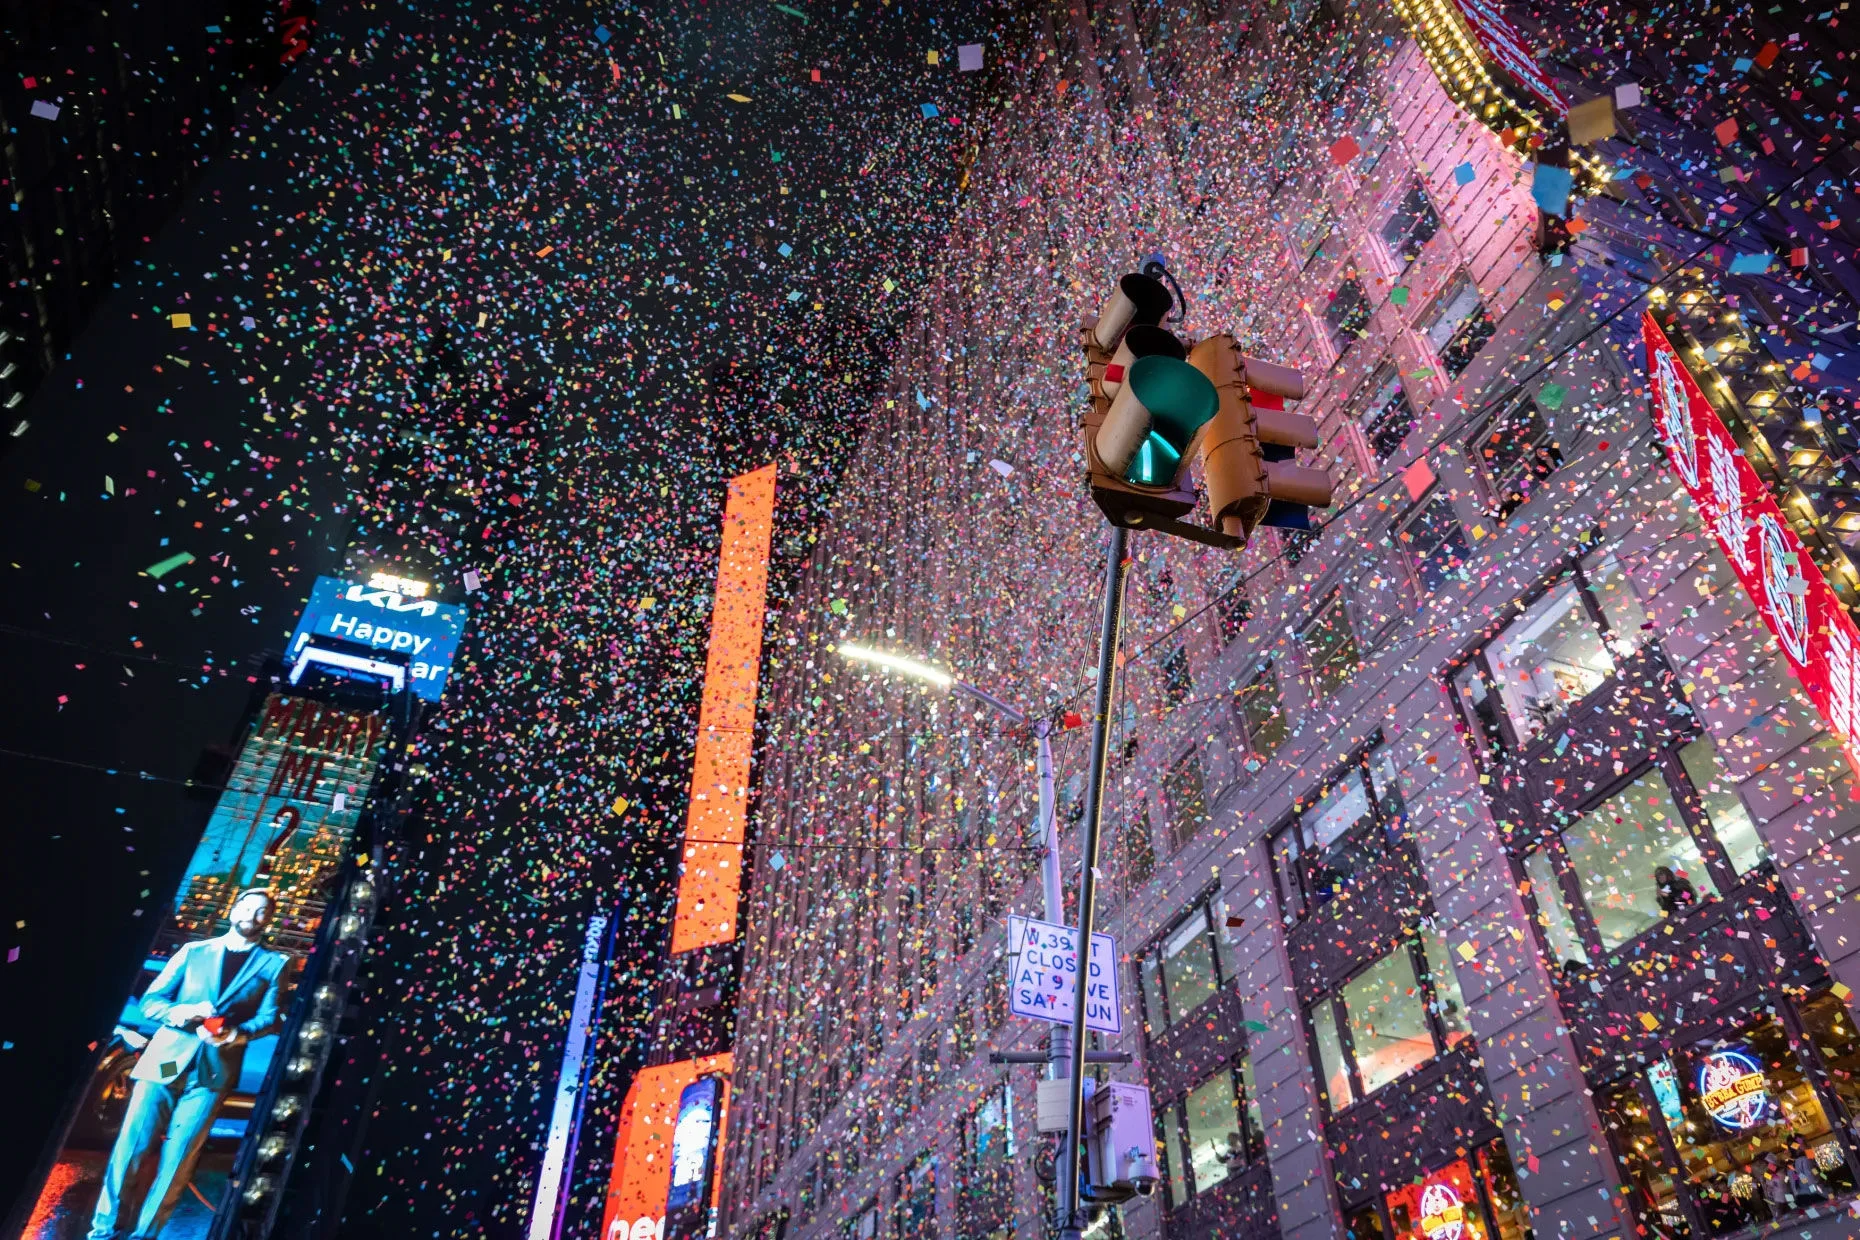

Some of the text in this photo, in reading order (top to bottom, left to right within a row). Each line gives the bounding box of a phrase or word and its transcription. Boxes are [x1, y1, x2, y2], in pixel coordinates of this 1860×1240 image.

[330, 613, 432, 655] Happy
[412, 661, 445, 681] ar
[258, 696, 386, 761] MARRY
[274, 751, 334, 803] ME
[1048, 934, 1072, 951] 39
[1027, 950, 1101, 977] CLOSD
[1021, 969, 1045, 986] AT
[1072, 982, 1109, 1000] VE
[1086, 1003, 1111, 1022] UN
